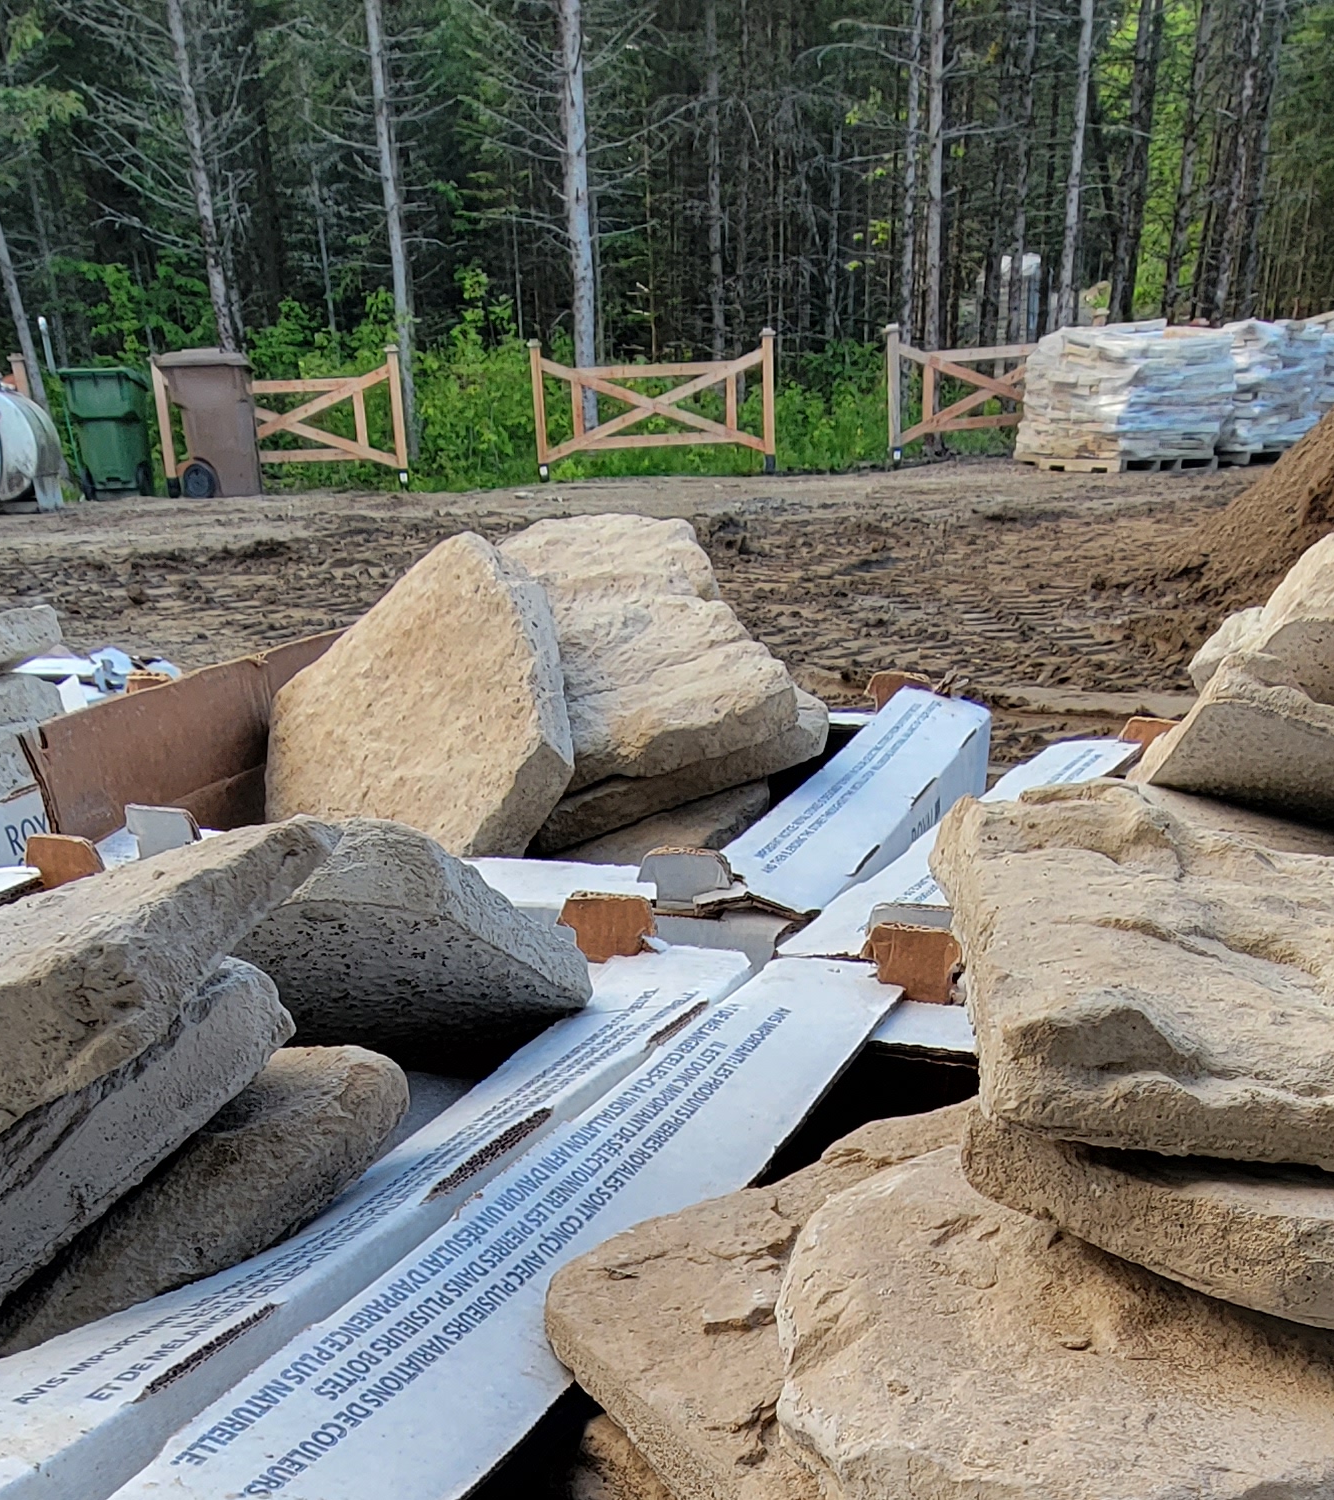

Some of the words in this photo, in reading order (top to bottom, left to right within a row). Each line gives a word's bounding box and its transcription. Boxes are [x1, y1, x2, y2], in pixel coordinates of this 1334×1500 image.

[696, 1047, 721, 1064] EST
[713, 1062, 738, 1079] LES
[620, 1083, 684, 1132] IMPORTANT
[674, 1076, 724, 1119] PRODUITS
[606, 1127, 637, 1146] DE
[641, 1114, 686, 1152] PIERRES
[534, 1139, 623, 1213] SÉLECTIONNER
[537, 1149, 573, 1174] AFIN
[602, 1148, 653, 1193] ROYALES
[485, 1167, 550, 1216] D'AVOIR
[574, 1187, 612, 1221] SONT
[468, 1205, 507, 1230] UN
[523, 1204, 555, 1227] LES
[537, 1214, 584, 1257] CONÇU
[410, 1224, 488, 1276] RÉSULTAT
[477, 1221, 534, 1268] PIERRES
[442, 1261, 489, 1297] DANS
[505, 1249, 553, 1284] AVEC
[319, 1269, 430, 1352] D'APPARENCE
[369, 1290, 454, 1356] PLUSIEURS
[442, 1277, 523, 1340] PLUSIEURS
[83, 1382, 123, 1401] ET
[112, 1362, 154, 1381] DE
[142, 1300, 255, 1360] MÉLANGER
[280, 1345, 335, 1385] PLUS
[358, 1334, 456, 1407] VARIATIONS
[11, 1376, 69, 1405] AVIS
[310, 1350, 382, 1401] BOÎTES
[169, 1378, 294, 1466] NATURELLE.
[333, 1402, 373, 1427] DE
[232, 1422, 347, 1499] COULEURS.
